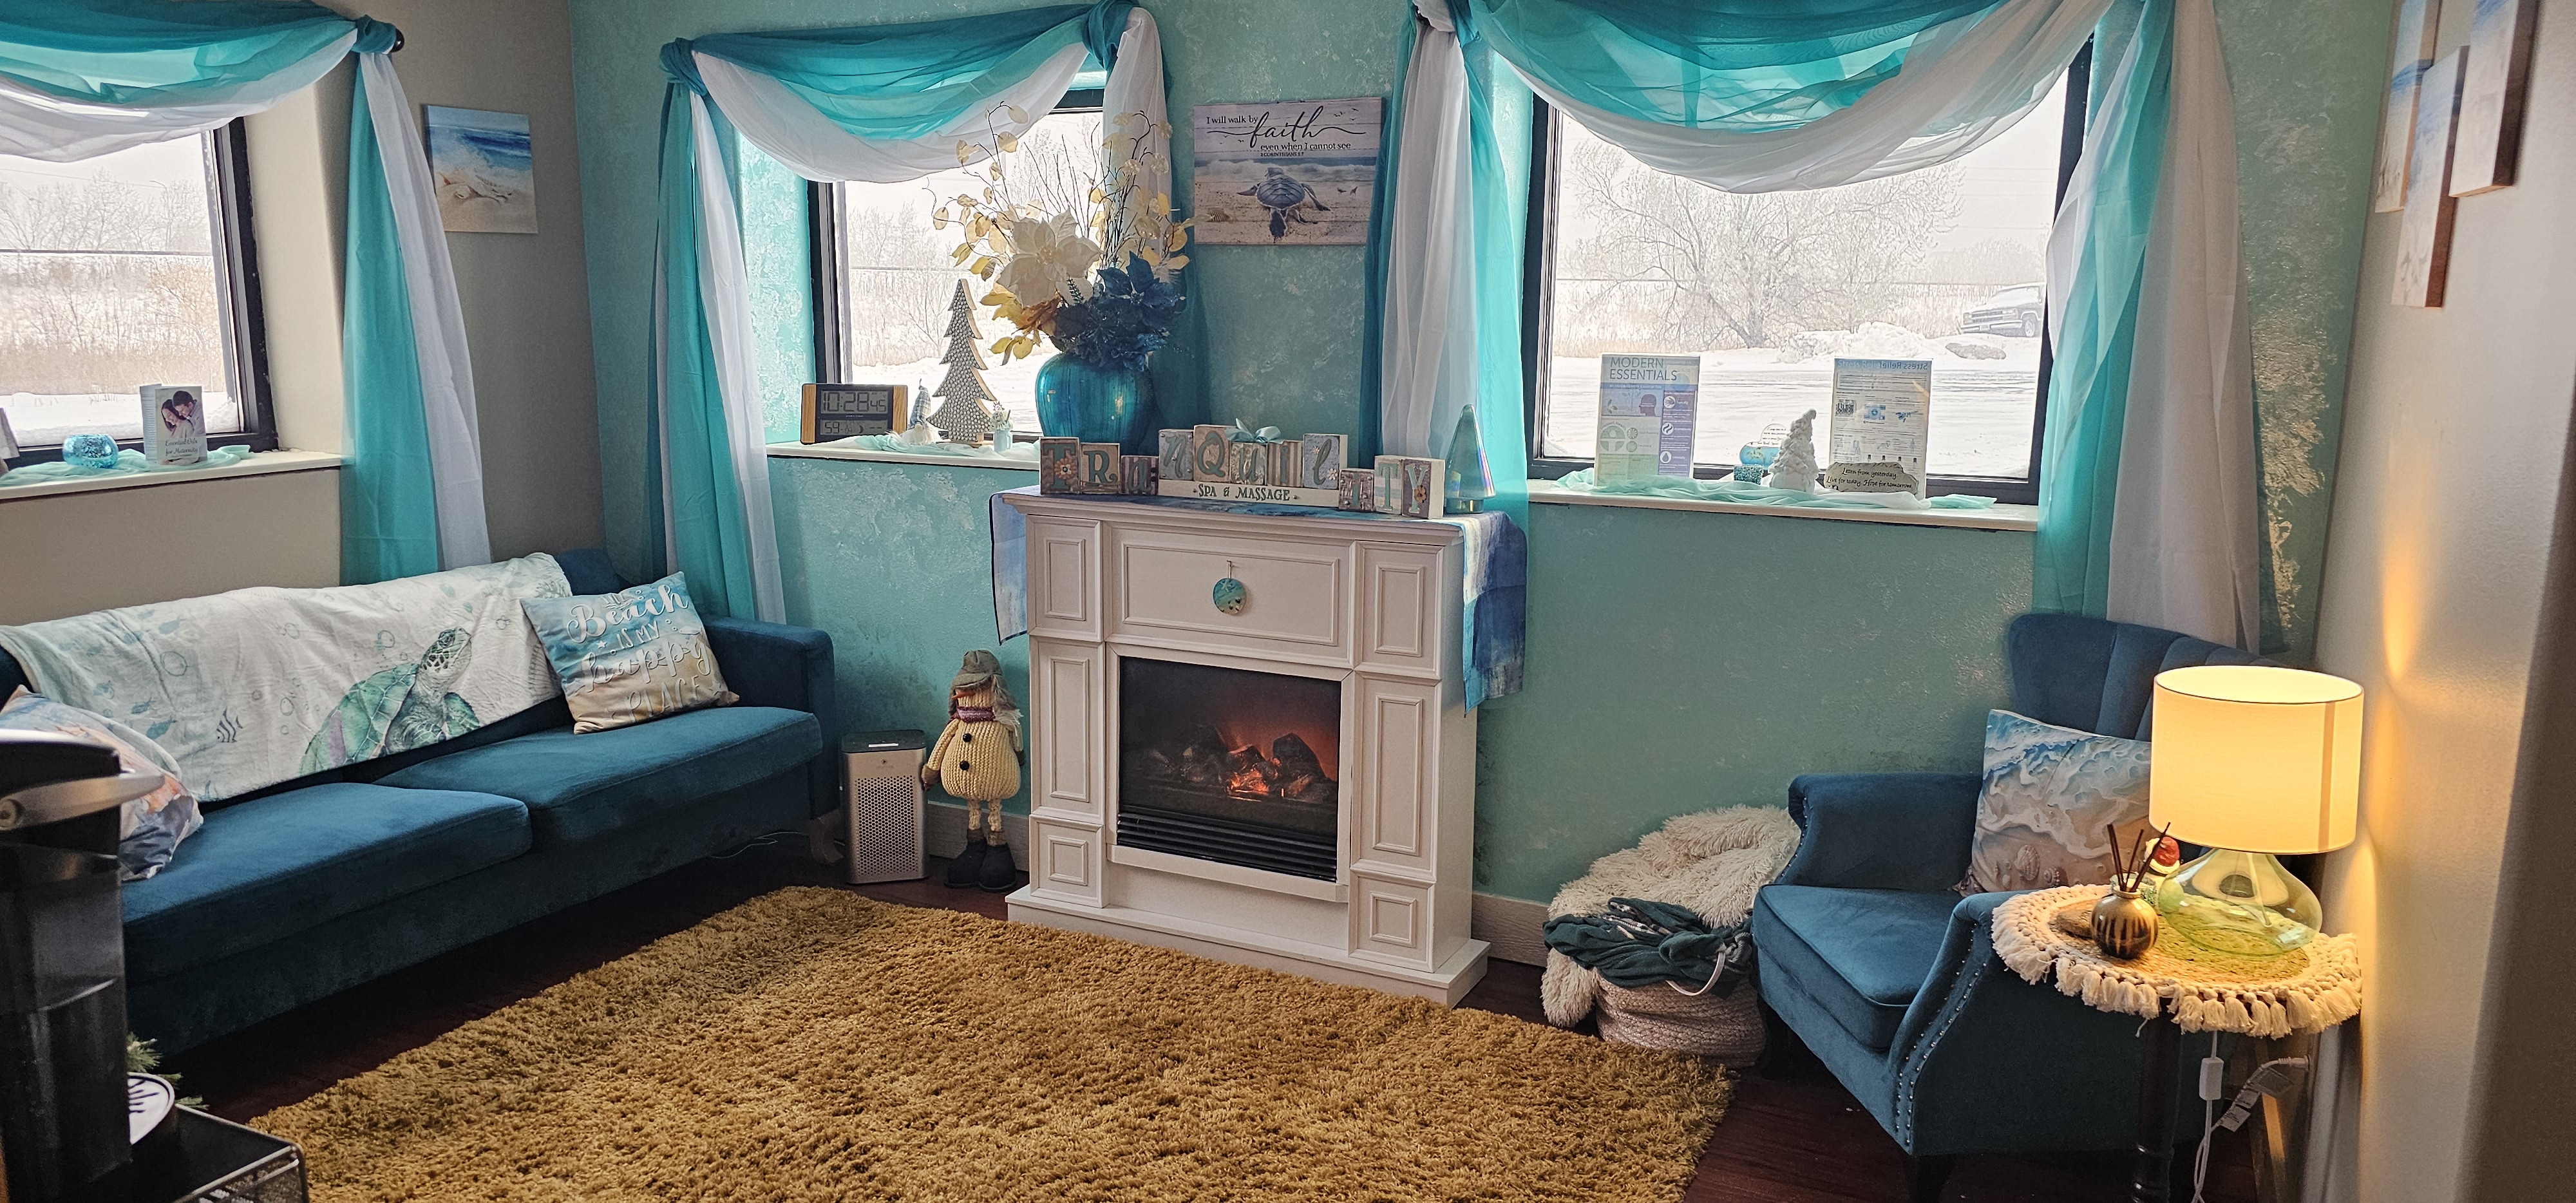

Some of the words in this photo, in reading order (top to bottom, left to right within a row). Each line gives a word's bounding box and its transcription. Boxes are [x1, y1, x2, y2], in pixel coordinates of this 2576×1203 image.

[1249, 115, 1258, 124] by
[1610, 357, 1664, 368] MODERN
[1610, 369, 1677, 381] ESSENTIALS
[824, 392, 869, 412] 10:28
[1871, 470, 1897, 480] yesterday
[1198, 484, 1217, 497] SPA
[1235, 487, 1291, 501] MASSAGE
[567, 585, 688, 643] Beach
[617, 628, 634, 649] IS
[636, 620, 659, 643] MY
[576, 637, 711, 693] happy
[626, 676, 700, 723] PLACE
